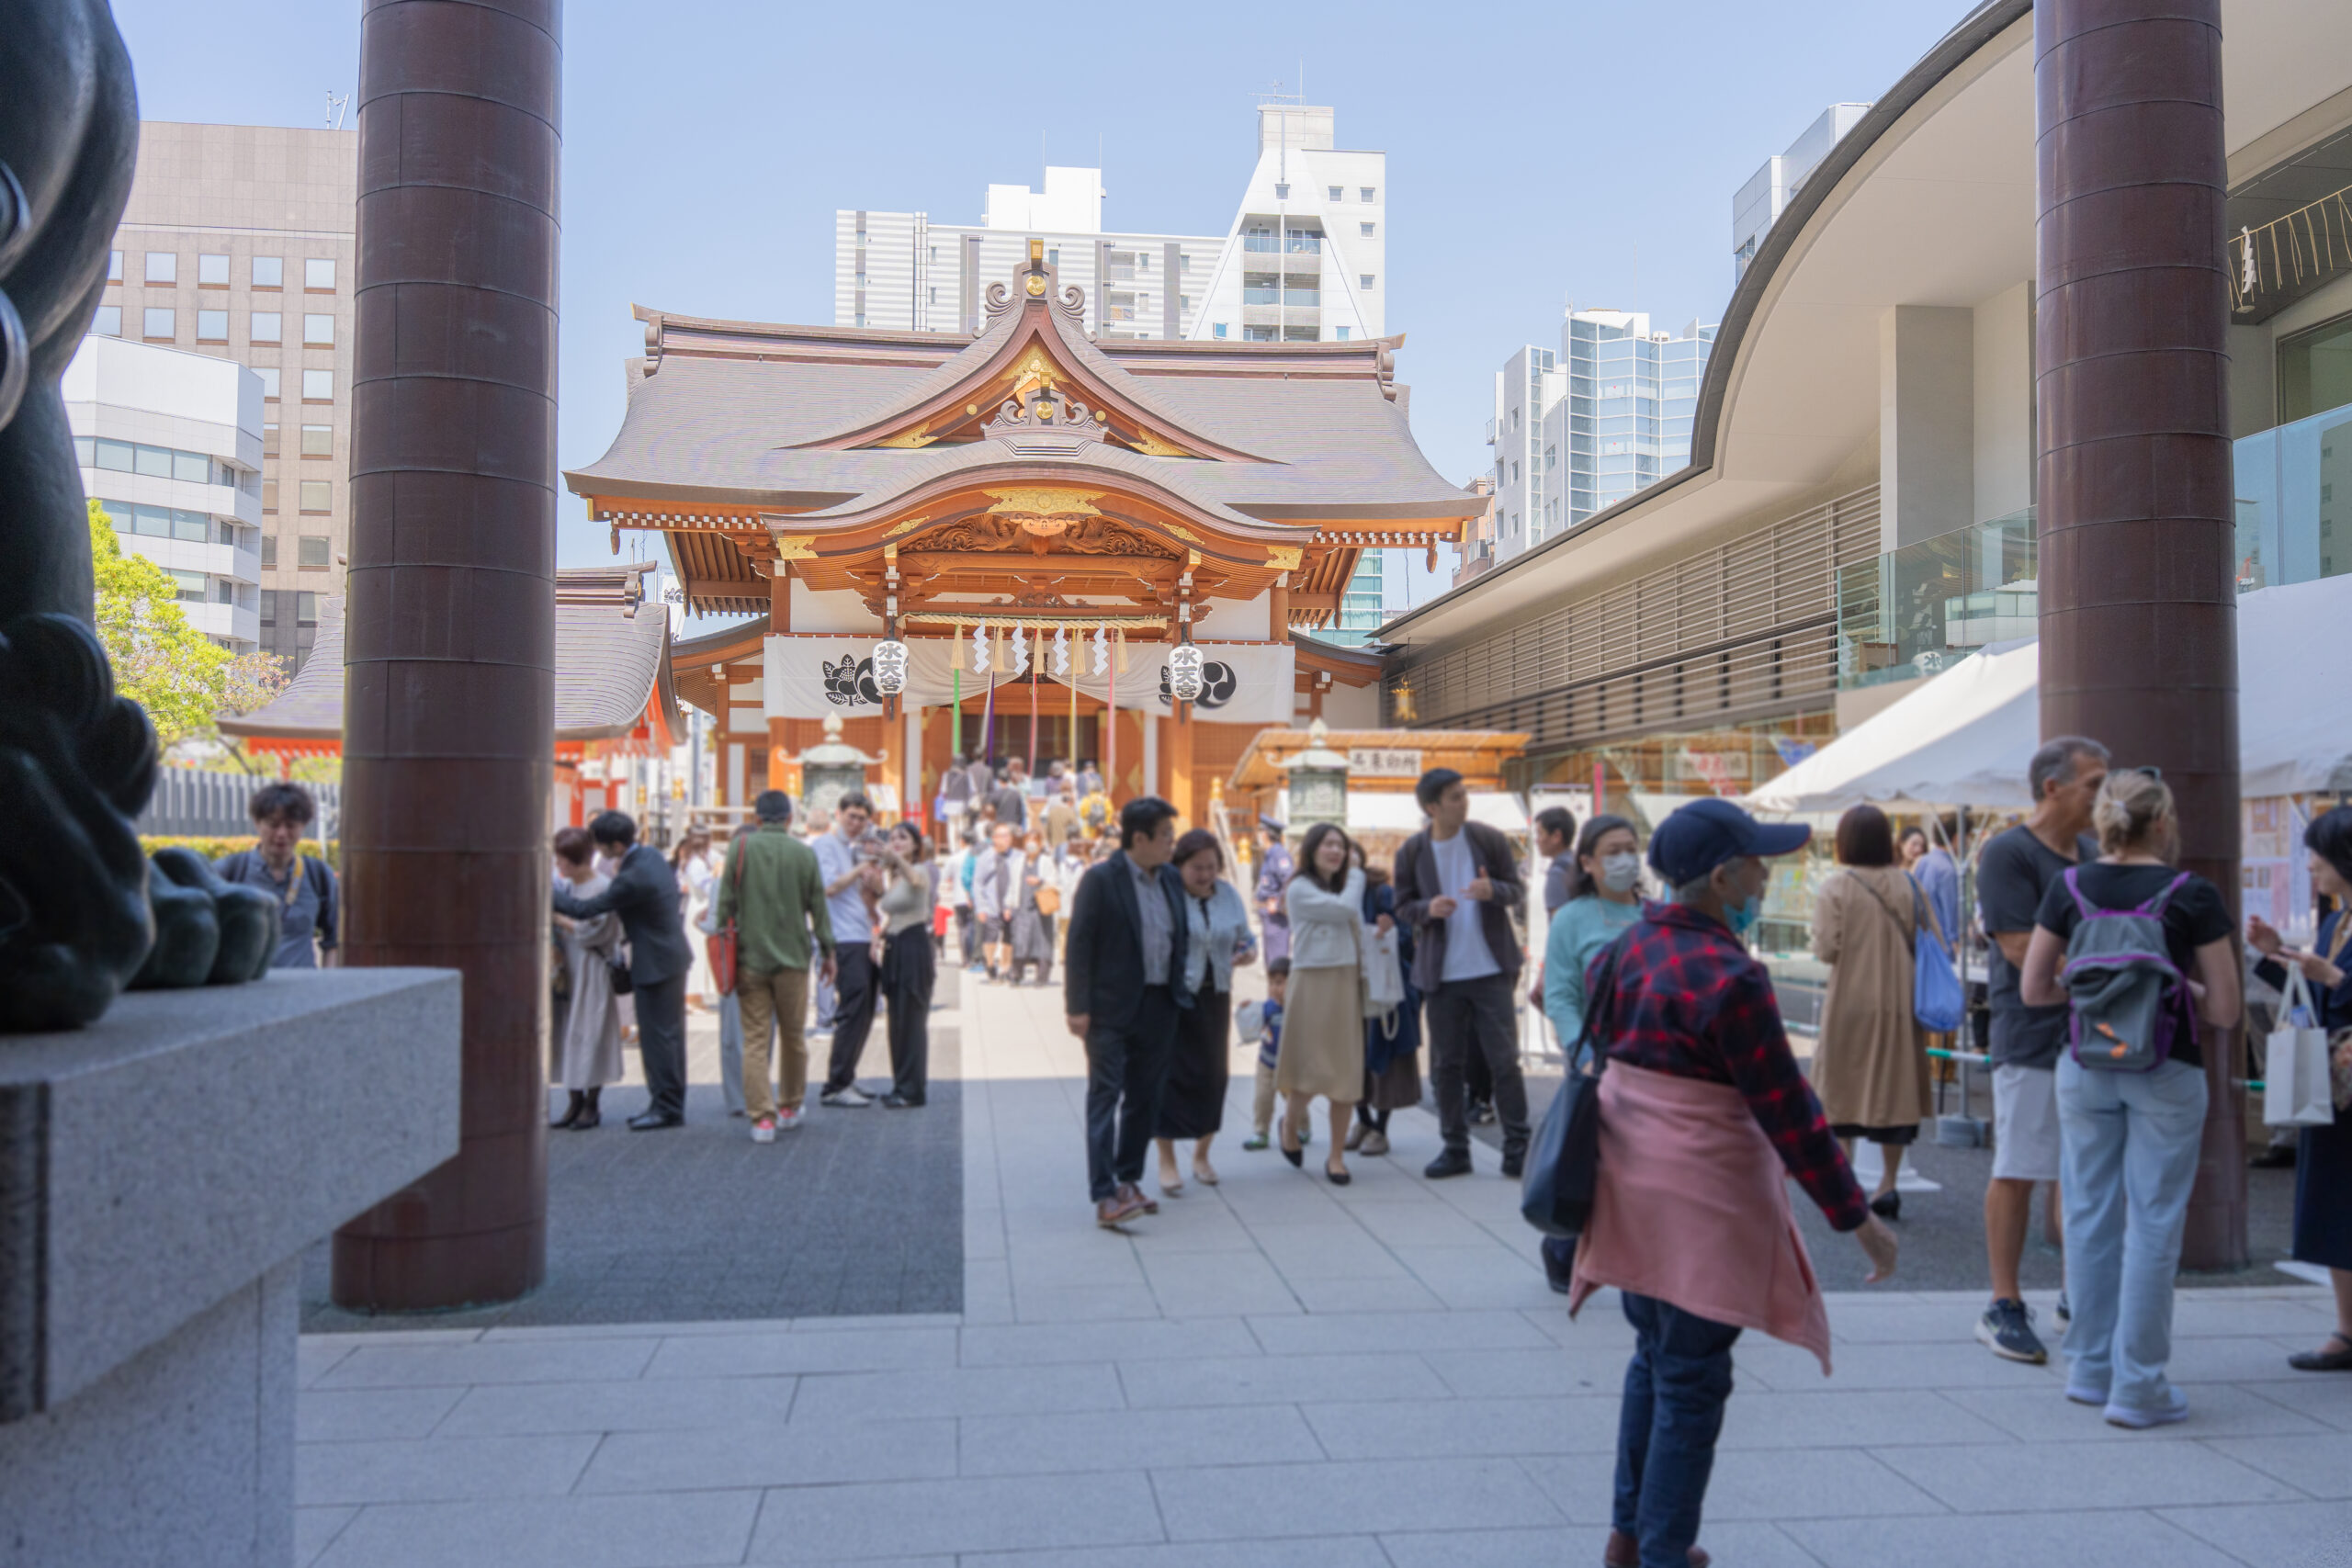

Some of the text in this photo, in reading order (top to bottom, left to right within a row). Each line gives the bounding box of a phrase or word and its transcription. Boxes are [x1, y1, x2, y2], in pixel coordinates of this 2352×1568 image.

[877, 643, 902, 691] 水天宮
[1174, 649, 1198, 697] 水天宮
